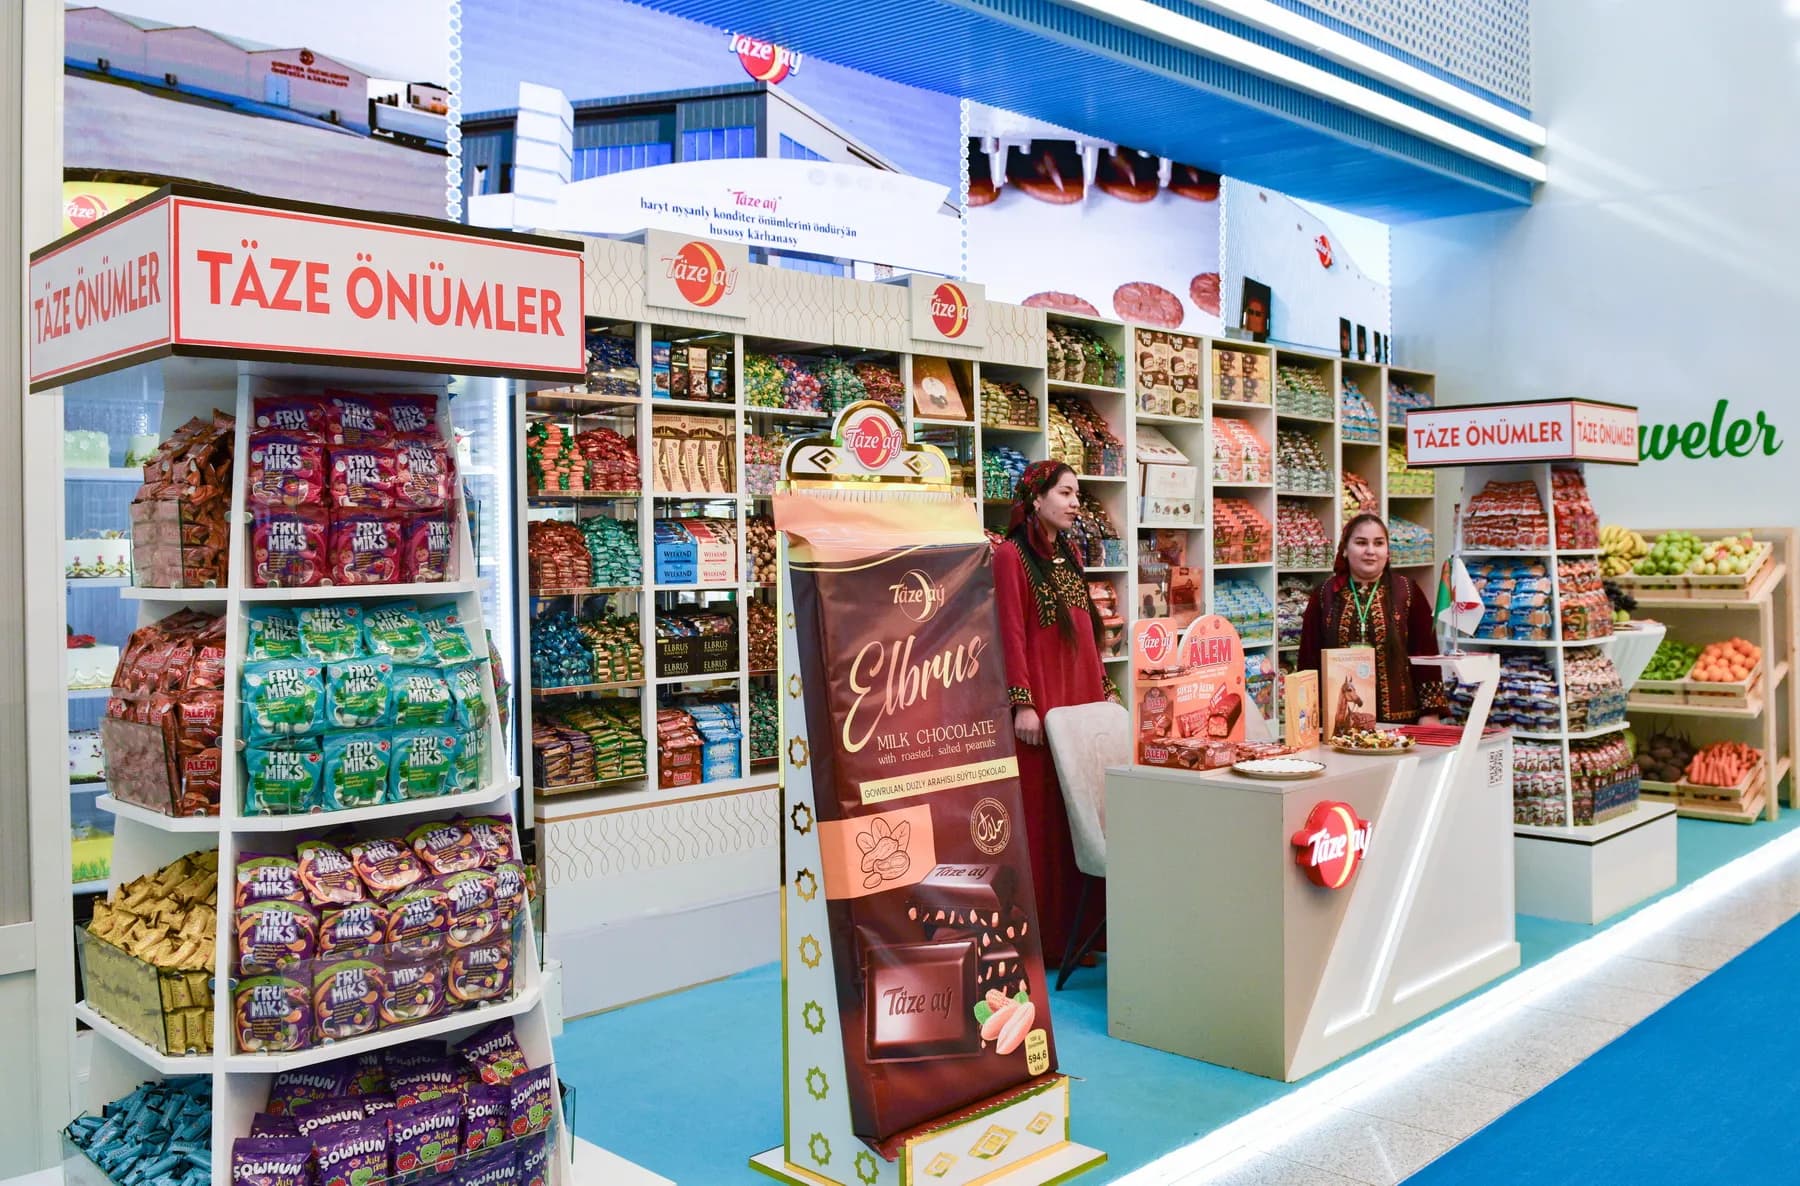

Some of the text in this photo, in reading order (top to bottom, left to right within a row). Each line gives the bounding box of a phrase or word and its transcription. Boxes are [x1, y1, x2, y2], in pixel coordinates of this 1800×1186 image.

[640, 197, 668, 212] haryt
[714, 207, 755, 224] konditer
[709, 224, 744, 239] hususy
[661, 254, 709, 283] Täze
[34, 251, 161, 344] TÄZE ÖNÜMLER
[197, 239, 565, 336] TÄZE ÖNÜMLER
[846, 428, 880, 449] Täze
[1414, 418, 1563, 448] TÄZE ÖNÜMLER
[1577, 416, 1598, 443] TÄZE
[889, 583, 923, 604] Täze
[664, 643, 688, 652] ELBRUS
[704, 640, 728, 649] ELBRUS
[348, 664, 374, 678] FRU
[664, 662, 688, 671] ELBRUS
[704, 659, 728, 669] ELBRUS
[268, 668, 298, 684] FRU
[843, 634, 988, 753] Elbrus
[413, 737, 437, 751] FRU
[877, 719, 996, 751] MILK CHOCOLATE
[346, 742, 373, 758] FRU
[878, 738, 996, 765] with roasted, salted peanuts
[906, 780, 926, 791] DUZLY
[1308, 828, 1347, 867] Täze
[259, 867, 290, 881] FRU
[935, 866, 966, 877] Täze
[261, 910, 293, 926] FRU
[336, 968, 364, 987] FRU
[883, 986, 953, 1019] Täze aý
[395, 1115, 455, 1145] ŞOWHUN
[319, 1139, 386, 1171] ŞOWHUN
[233, 1162, 302, 1182] ŞOWHUN
